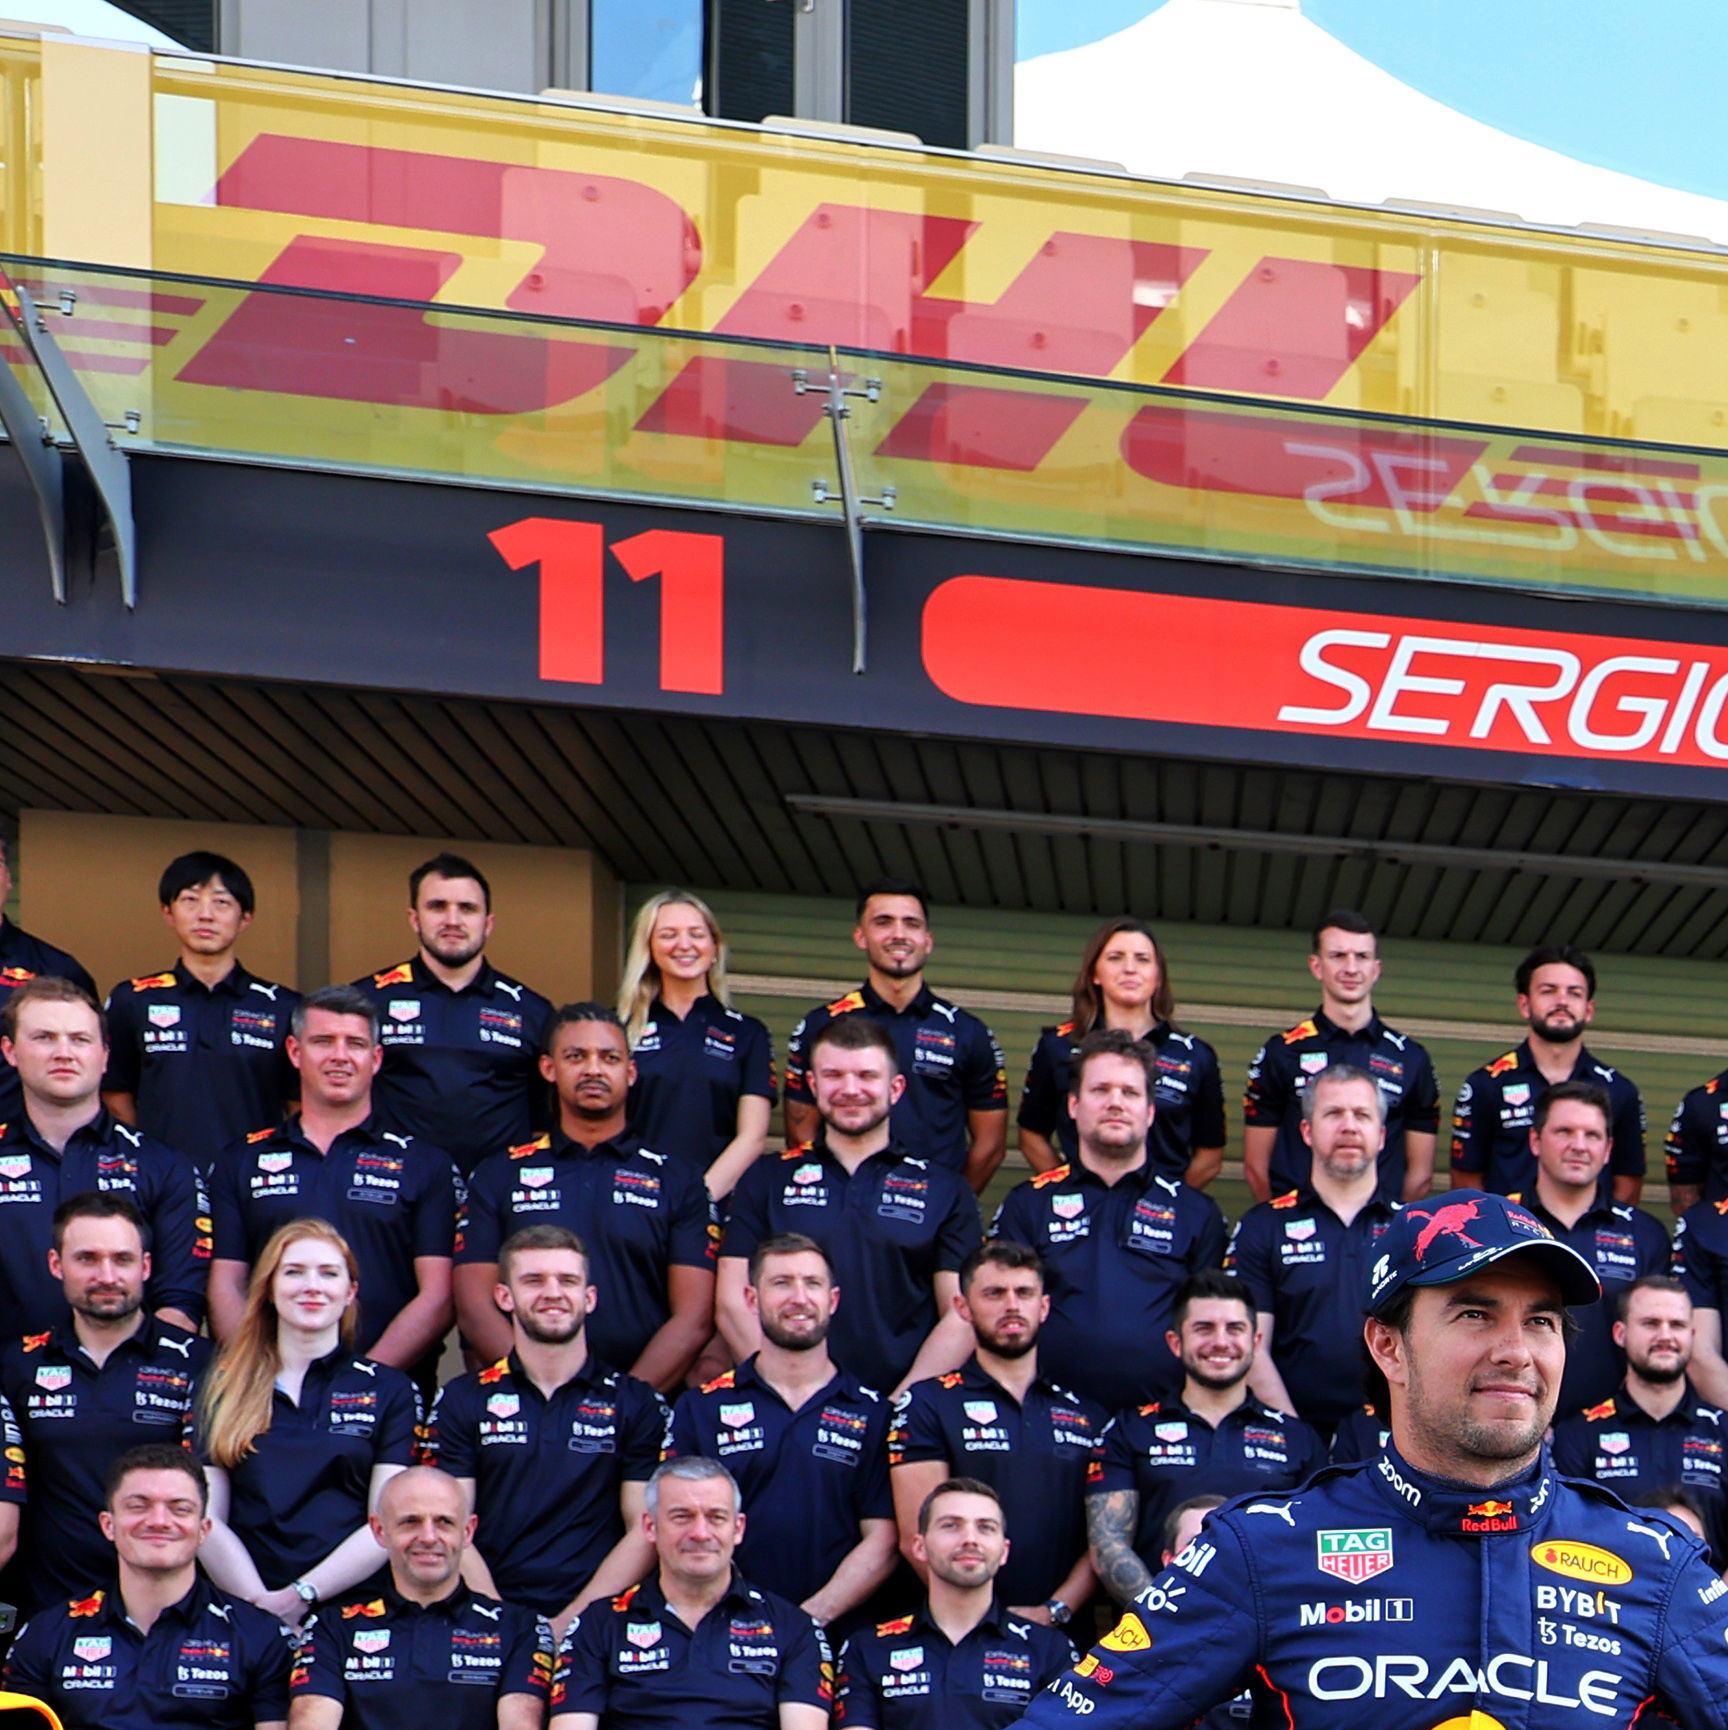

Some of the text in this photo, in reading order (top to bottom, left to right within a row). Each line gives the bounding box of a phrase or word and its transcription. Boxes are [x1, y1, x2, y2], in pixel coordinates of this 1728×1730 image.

[173, 131, 1485, 498] DHL
[487, 517, 724, 695] 11
[28, 1408, 75, 1419] ORACLE
[1150, 1455, 1195, 1467] ORACLE
[1378, 1455, 1422, 1507] zoom
[1462, 1517, 1517, 1531] Red Bull
[1323, 1532, 1386, 1552] TAG
[1173, 1539, 1217, 1577] bil
[1560, 1551, 1619, 1579] RAUCH
[1323, 1555, 1391, 1582] HEUER
[1300, 1599, 1381, 1626] Mobil
[1537, 1585, 1621, 1624] BYBIT
[1562, 1624, 1621, 1656] Tezos
[464, 1656, 501, 1667] Tezos
[742, 1646, 778, 1657] Tezos
[192, 1668, 229, 1681] Tezos
[344, 1671, 393, 1681] ORACLE
[619, 1662, 669, 1672] ORACLE
[62, 1679, 114, 1690] ORACLE
[882, 1685, 930, 1697] ORACLE
[1308, 1653, 1623, 1717] ORACLE
